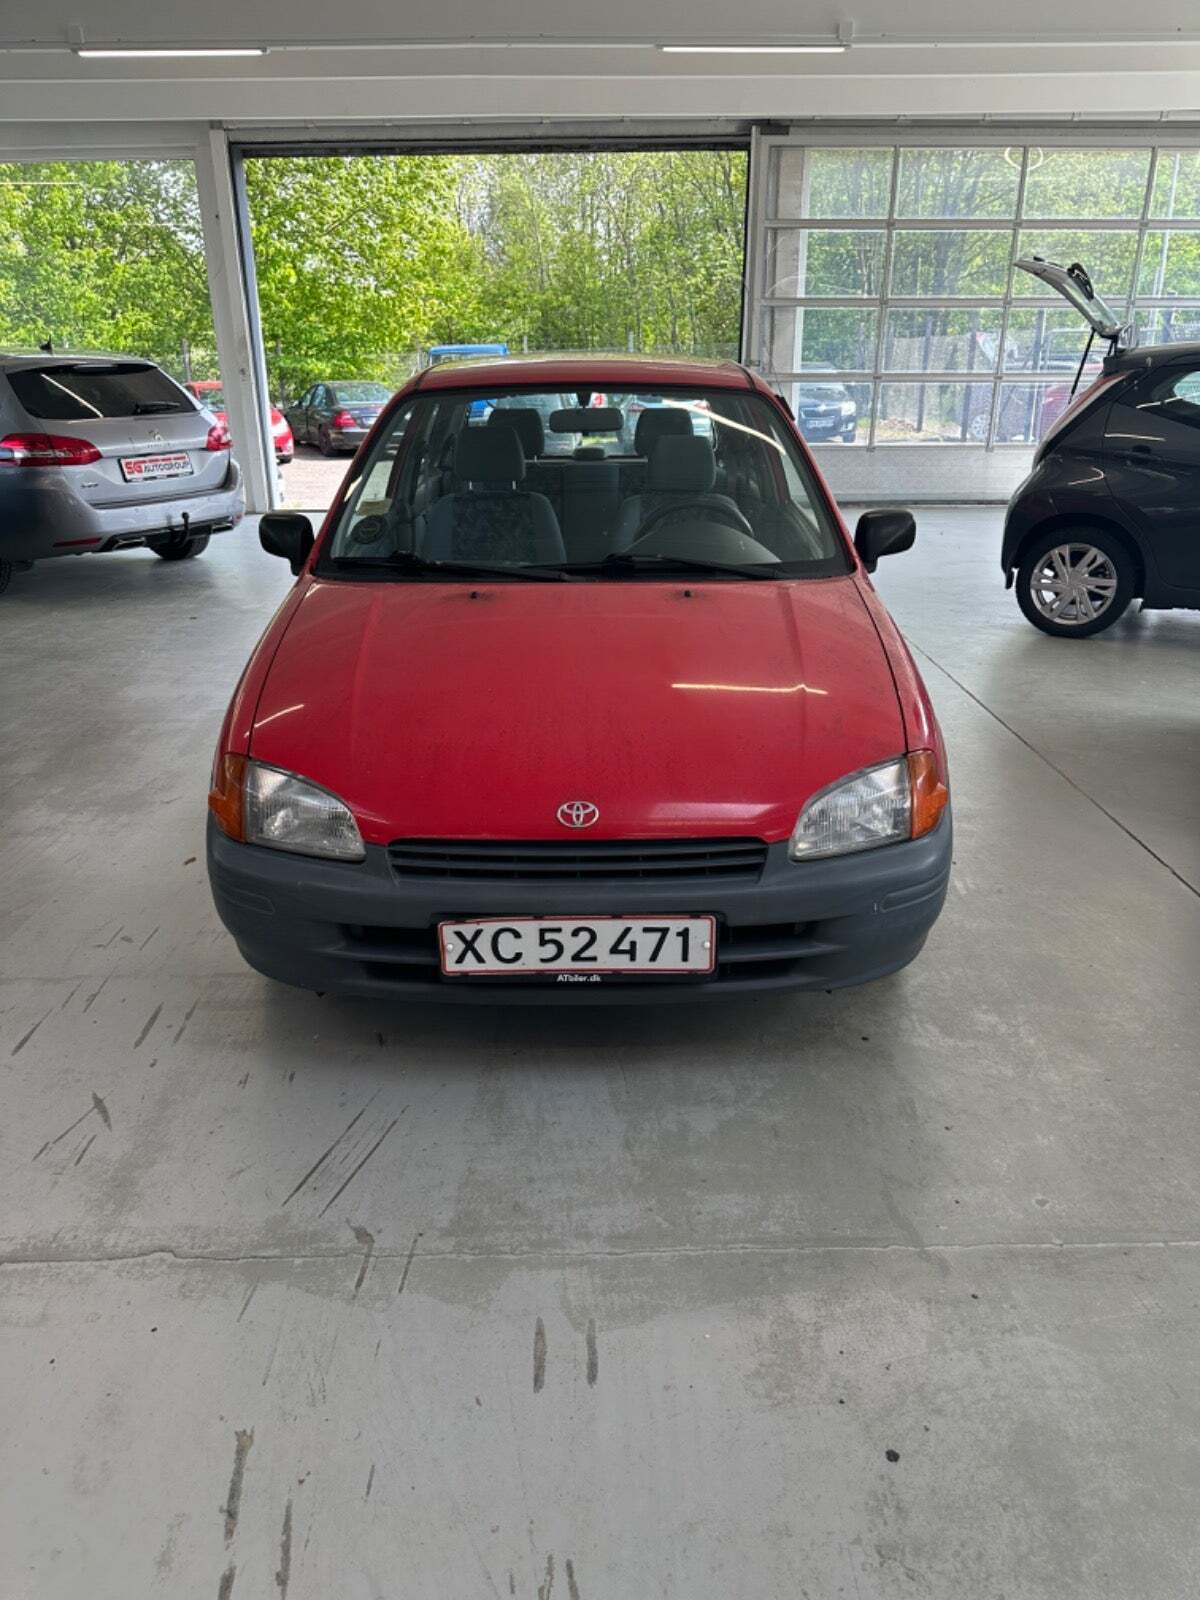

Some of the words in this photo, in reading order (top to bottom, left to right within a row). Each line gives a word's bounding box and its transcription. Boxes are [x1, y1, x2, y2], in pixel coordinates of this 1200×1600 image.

[125, 460, 144, 474] SG
[453, 927, 523, 964] XC
[538, 926, 598, 963] 52
[608, 926, 690, 963] 471
